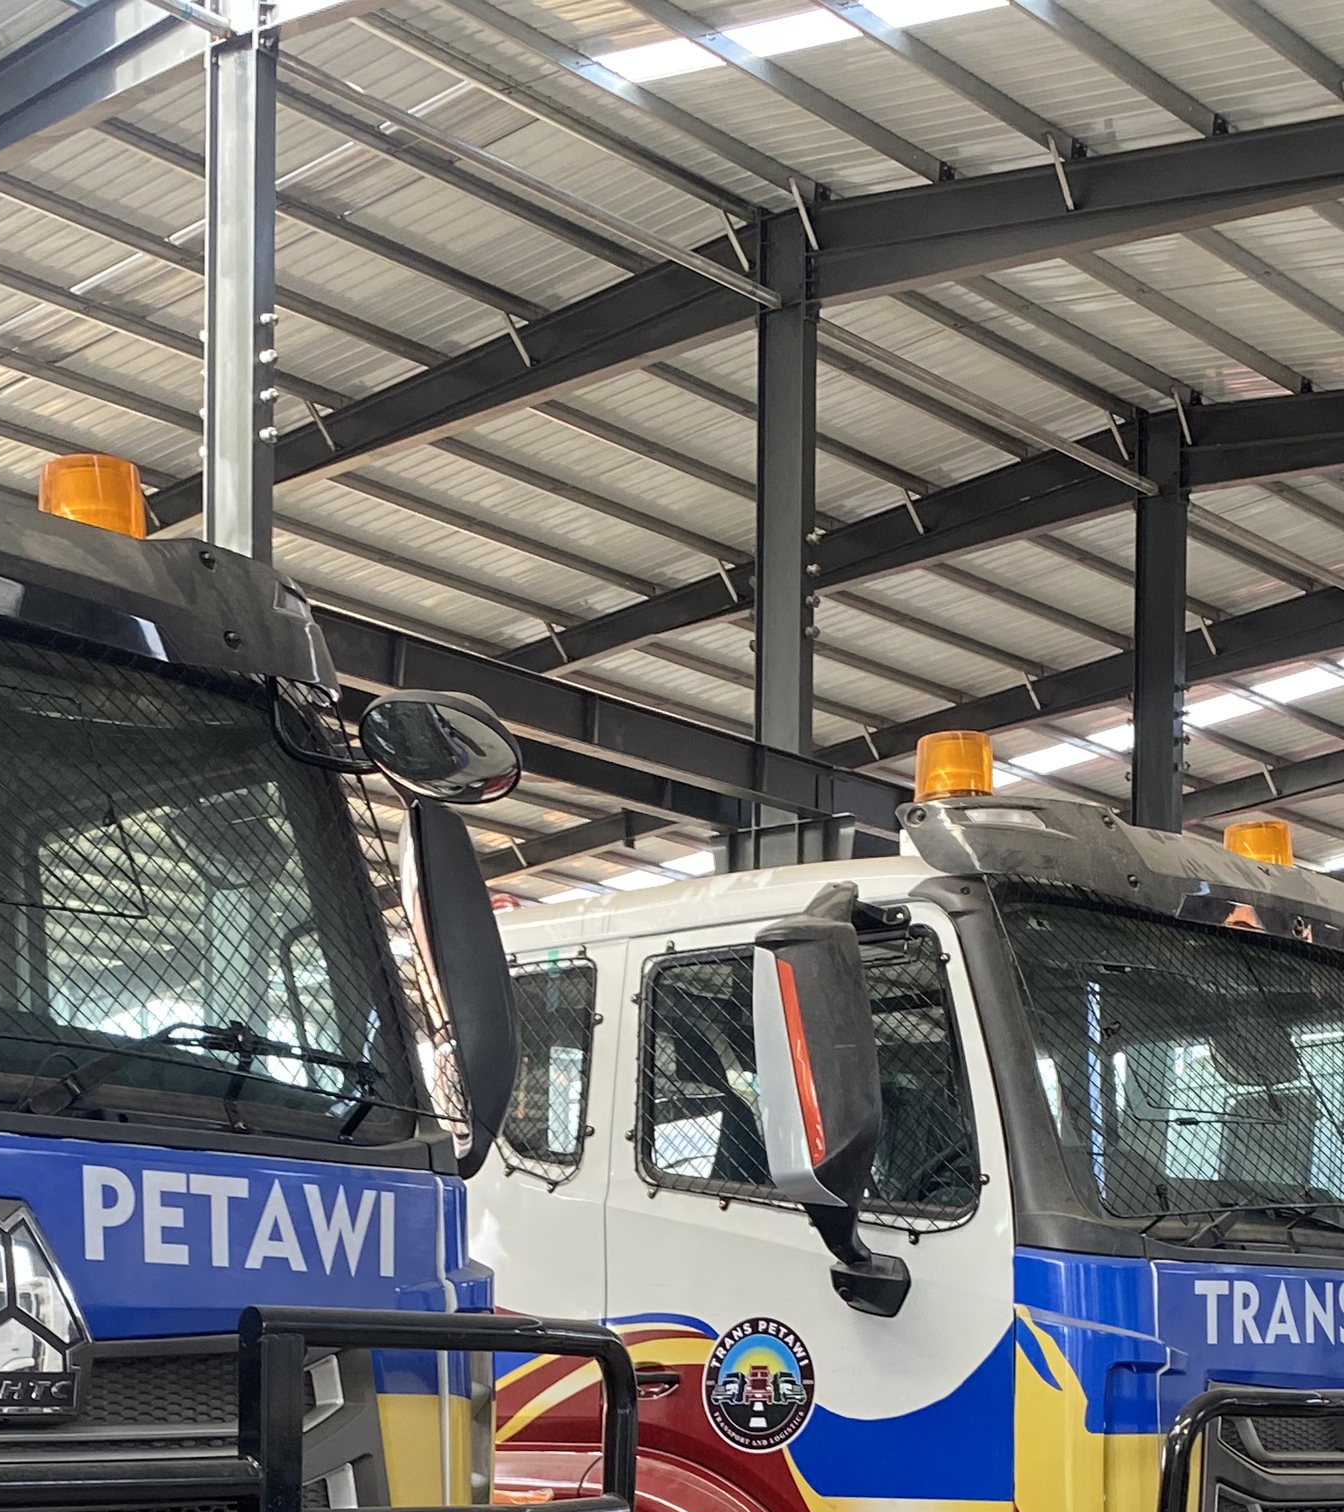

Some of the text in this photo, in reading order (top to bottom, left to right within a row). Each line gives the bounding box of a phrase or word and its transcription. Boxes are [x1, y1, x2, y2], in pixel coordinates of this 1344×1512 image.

[82, 1164, 396, 1278] PETAWI
[710, 1320, 809, 1369] TRANS PETAWI
